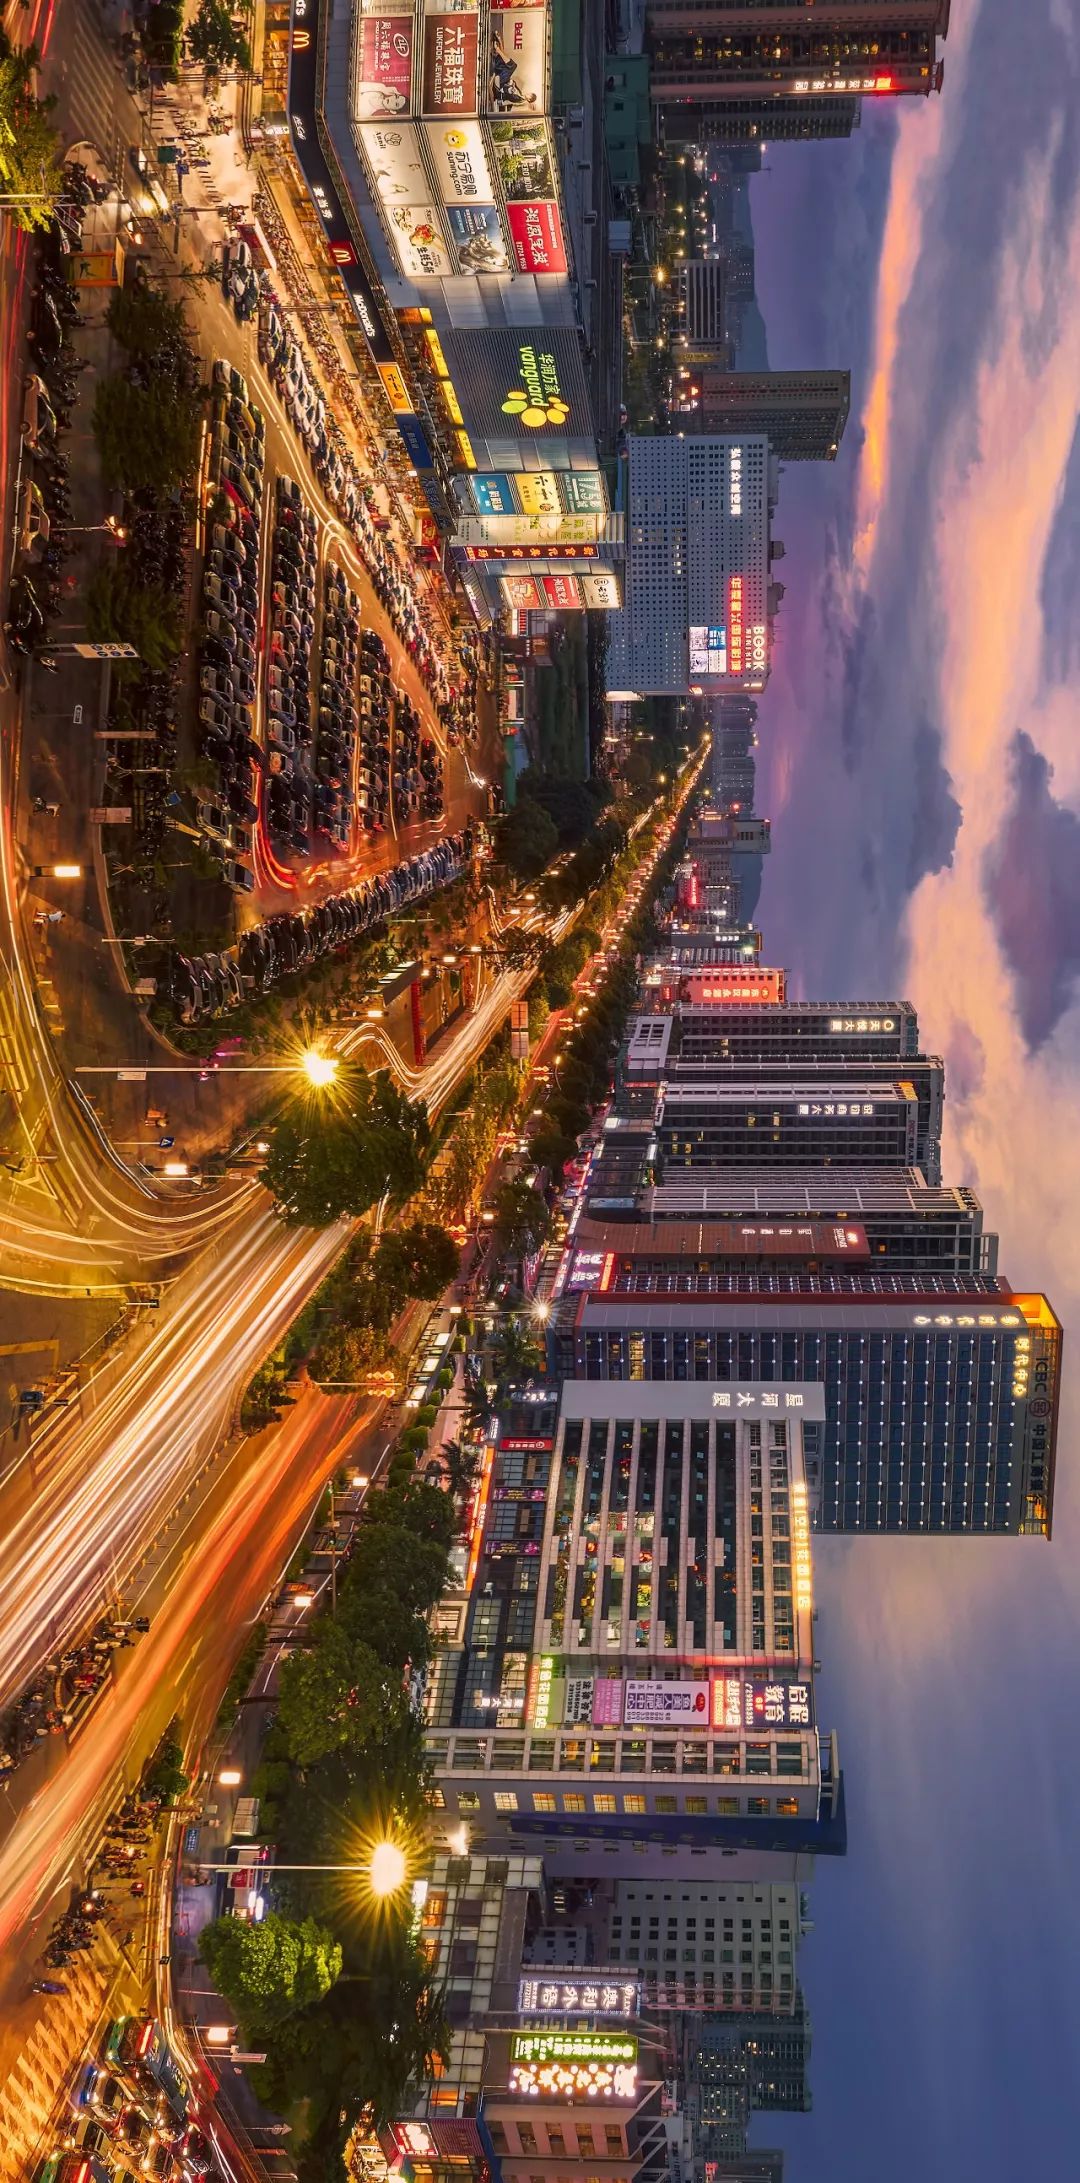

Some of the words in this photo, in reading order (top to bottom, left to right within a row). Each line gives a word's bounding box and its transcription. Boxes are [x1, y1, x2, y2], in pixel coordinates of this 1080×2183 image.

[380, 20, 392, 72] 周六福珠宝
[435, 27, 444, 61] LUKFOOK
[442, 26, 464, 104] 六福珠寶
[434, 62, 442, 104] JEWELLERY
[446, 152, 463, 196] suning.com
[454, 151, 478, 196] 苏宁易购
[312, 187, 332, 219] 麦当劳
[352, 294, 377, 337] McDonald's
[519, 346, 548, 406] vanguard
[538, 353, 560, 395] 华润万家
[752, 626, 765, 671] BOOK
[1034, 1357, 1047, 1392] ICBC
[711, 1392, 804, 1407] 星河大厦
[1030, 1424, 1046, 1505] 中国工商银行
[528, 1696, 537, 1720] TOWER
[580, 1681, 591, 1722] 法律咨询
[764, 1685, 785, 1722] 教育
[788, 1686, 808, 1722] 启程
[540, 1986, 618, 2009] 奥利外语
